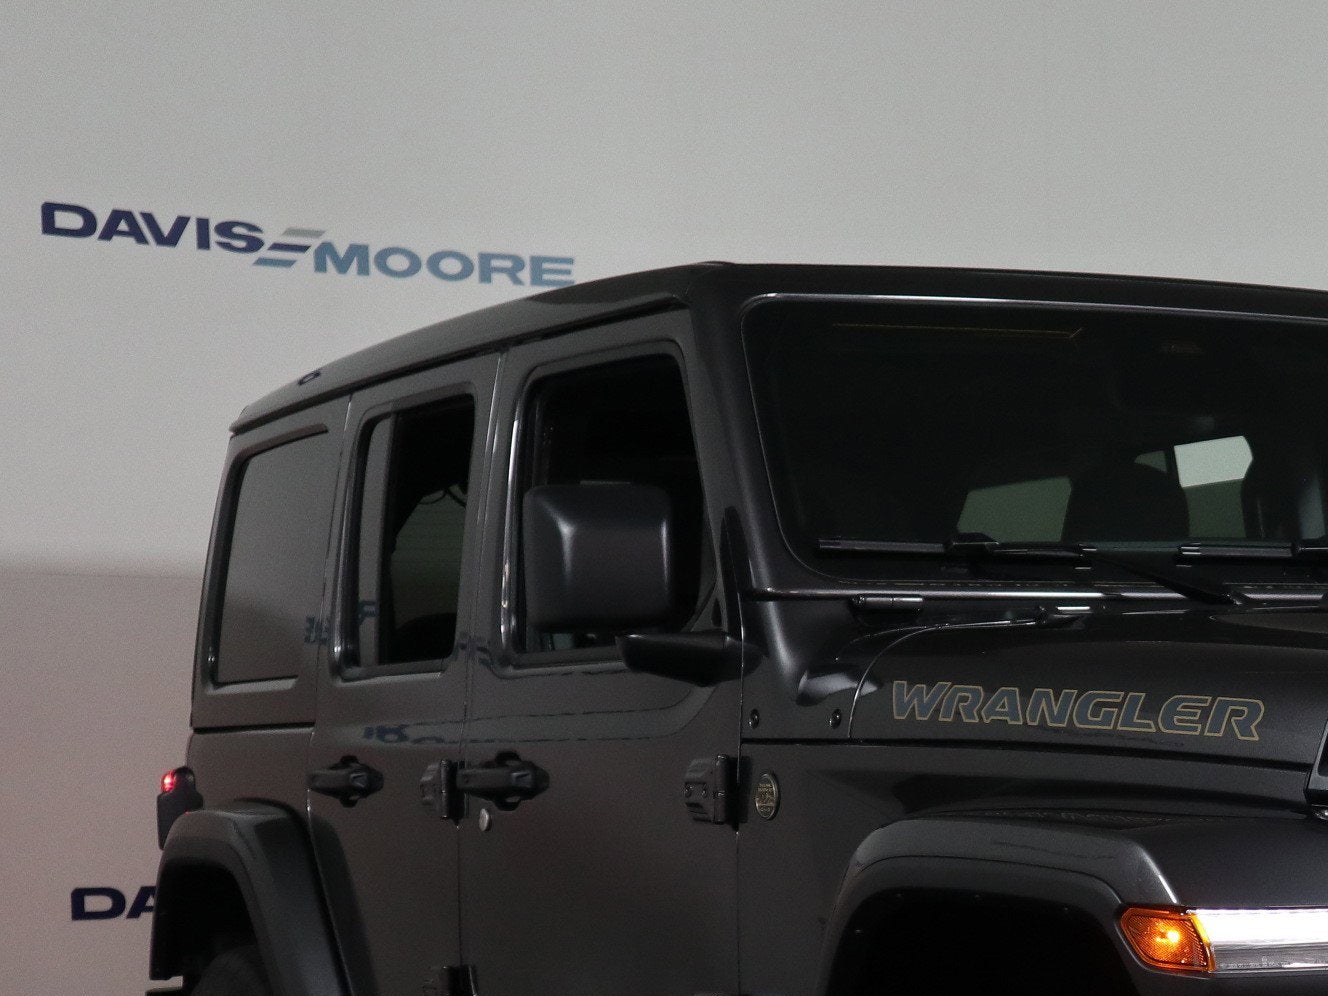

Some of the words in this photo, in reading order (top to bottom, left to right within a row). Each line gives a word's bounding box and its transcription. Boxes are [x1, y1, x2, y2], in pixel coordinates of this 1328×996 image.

[40, 201, 265, 253] DAVIS
[314, 242, 576, 288] MOORE
[892, 680, 1265, 741] WRANGLER
